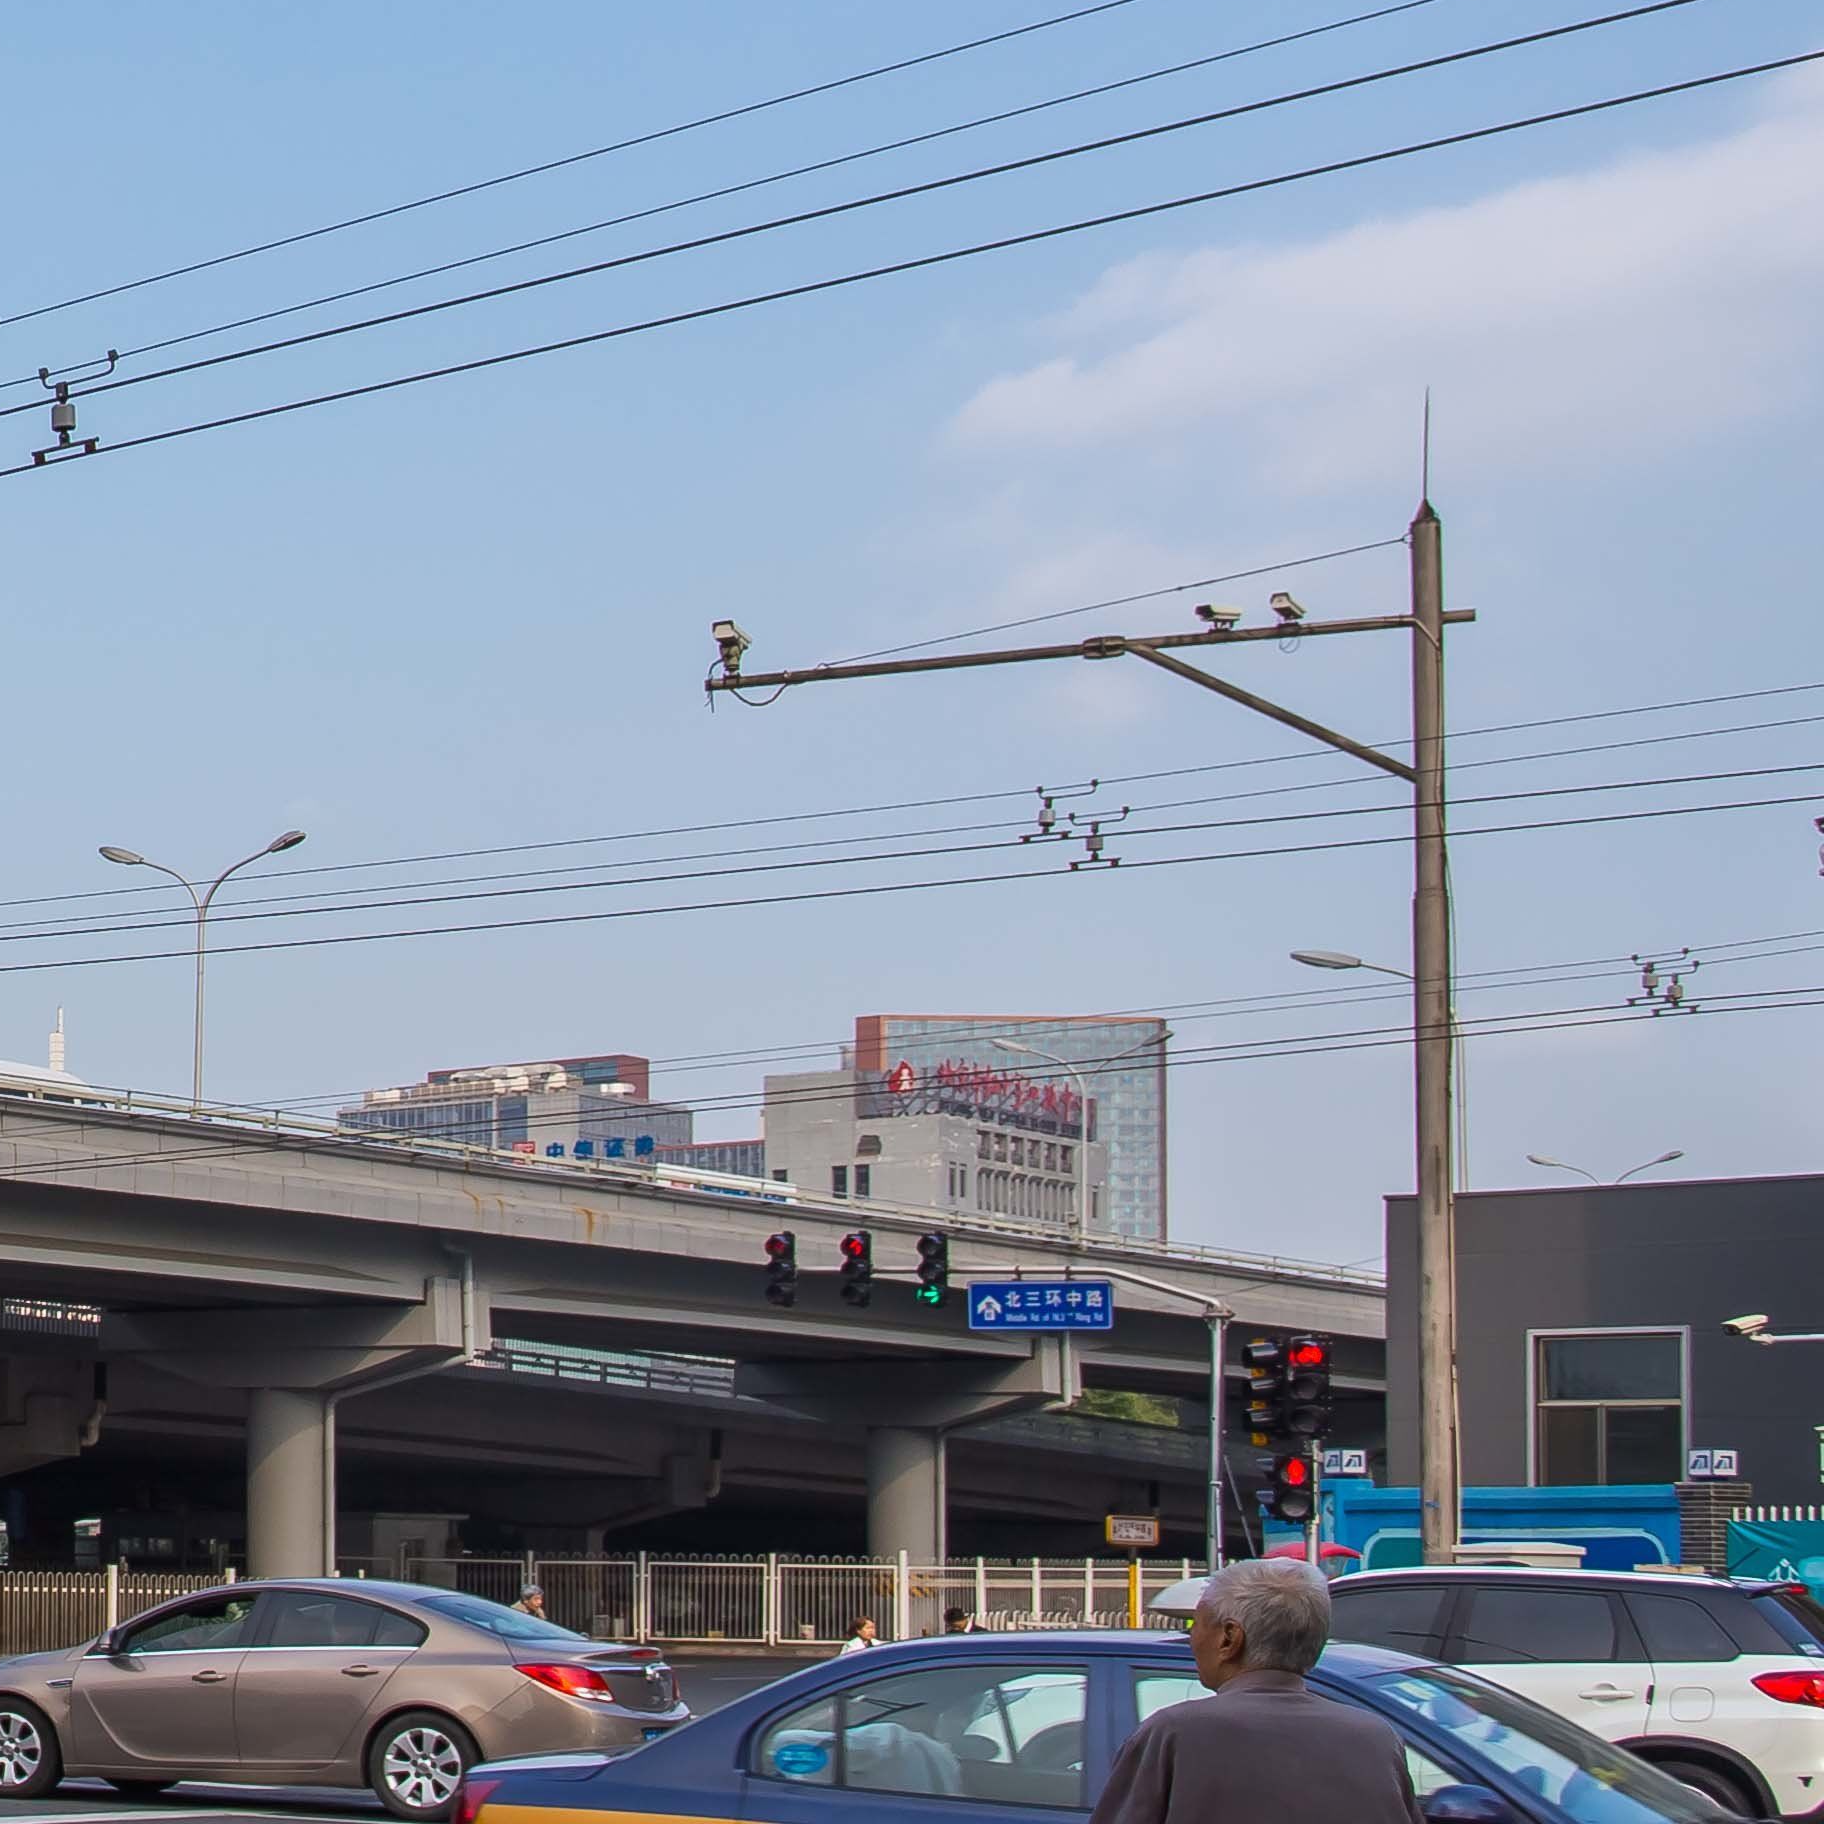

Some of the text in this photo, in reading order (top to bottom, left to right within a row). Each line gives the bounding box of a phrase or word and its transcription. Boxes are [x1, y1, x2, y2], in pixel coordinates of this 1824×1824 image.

[1006, 1290, 1103, 1307] 北三环中路
